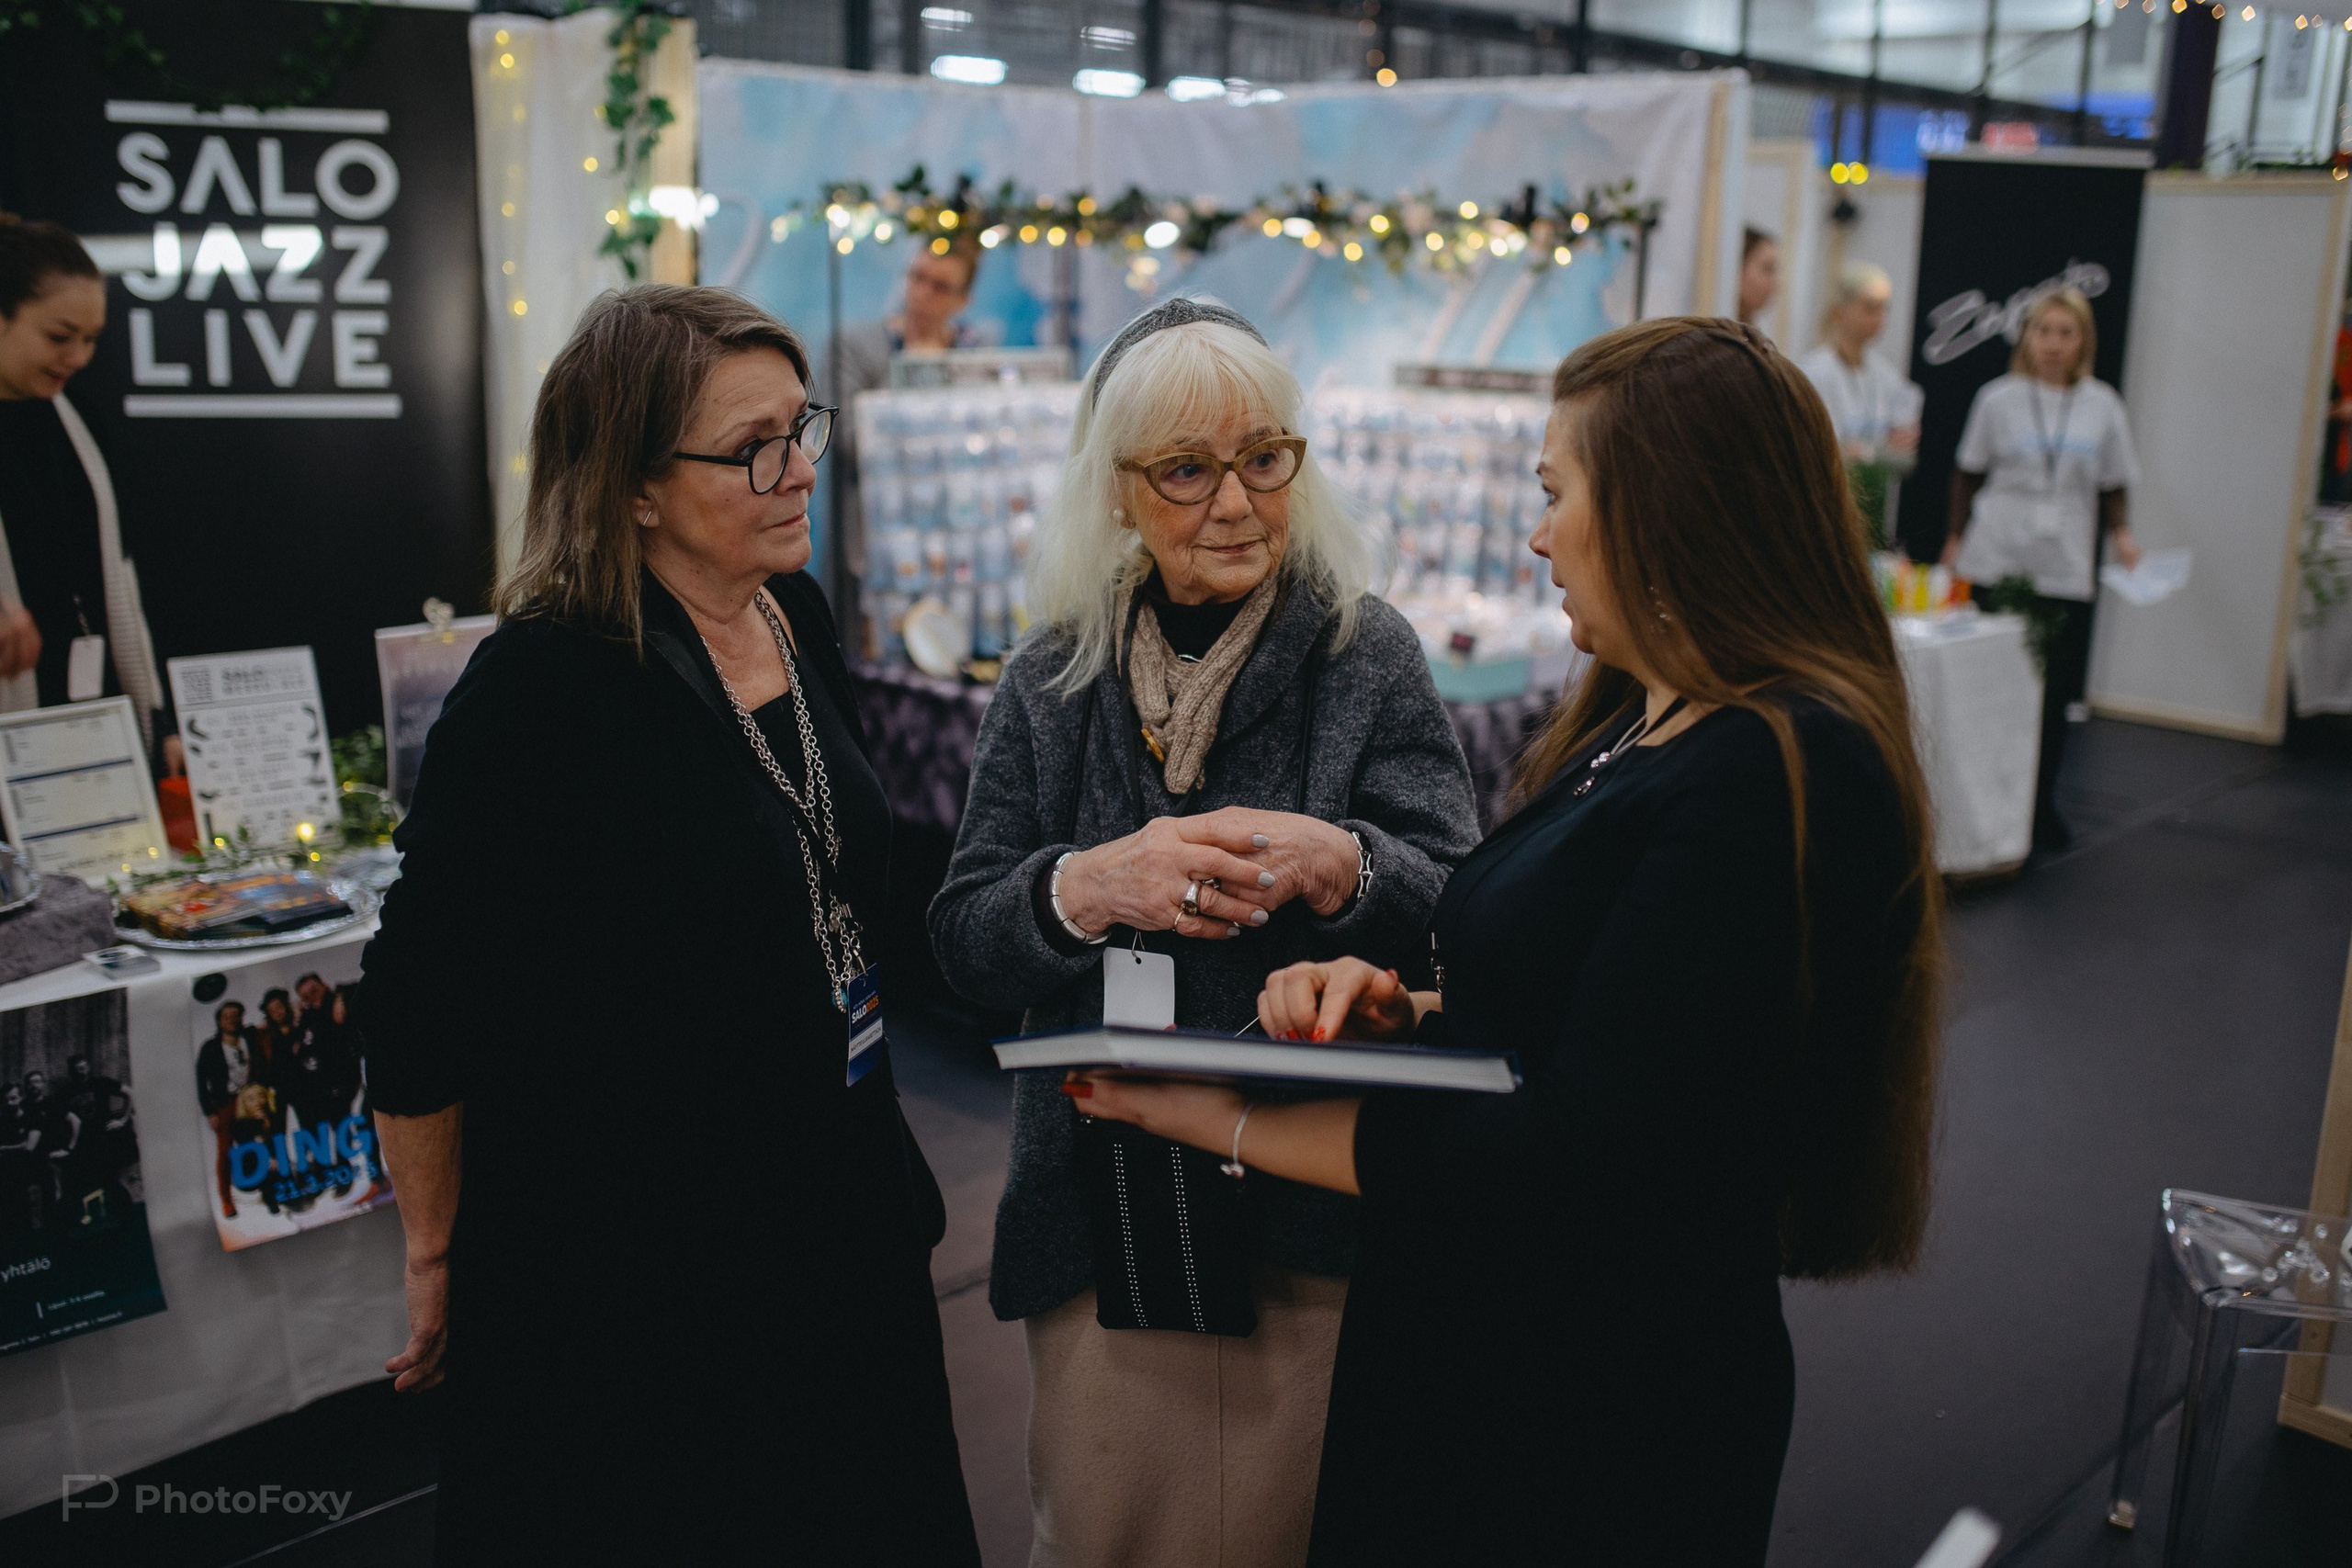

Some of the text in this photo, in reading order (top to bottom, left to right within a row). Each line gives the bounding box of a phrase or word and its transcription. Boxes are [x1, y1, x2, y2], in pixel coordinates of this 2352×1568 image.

[116, 131, 401, 220] SALO
[121, 222, 391, 304] JAZZ
[128, 309, 392, 388] LIVE
[228, 1113, 380, 1190] DING
